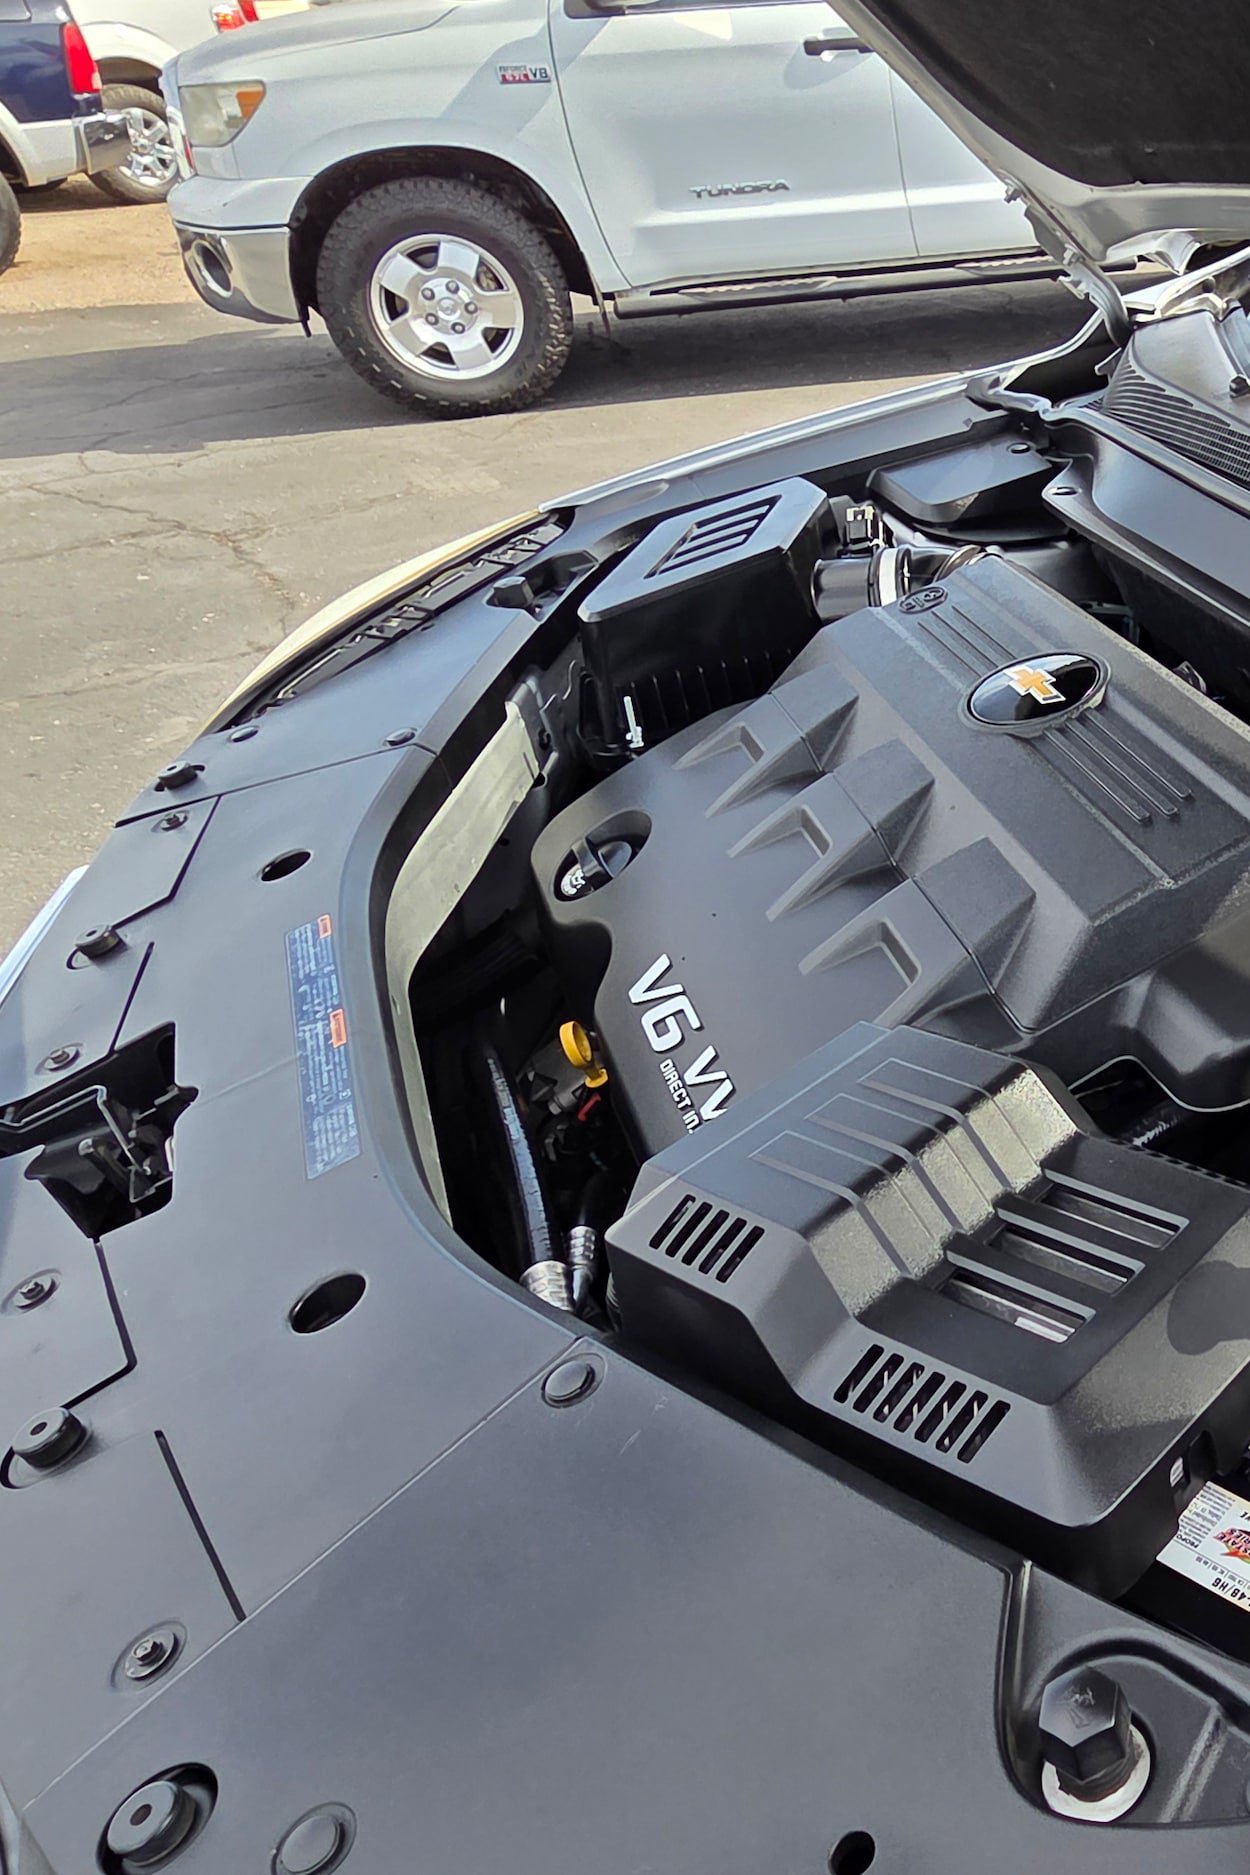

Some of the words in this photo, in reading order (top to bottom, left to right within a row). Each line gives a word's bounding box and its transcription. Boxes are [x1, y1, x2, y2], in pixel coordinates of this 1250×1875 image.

[529, 67, 548, 78] V8
[689, 180, 789, 199] TUNDRA
[628, 953, 701, 1052] V6
[659, 1058, 691, 1109] DIRECT
[682, 1110, 700, 1135] IN
